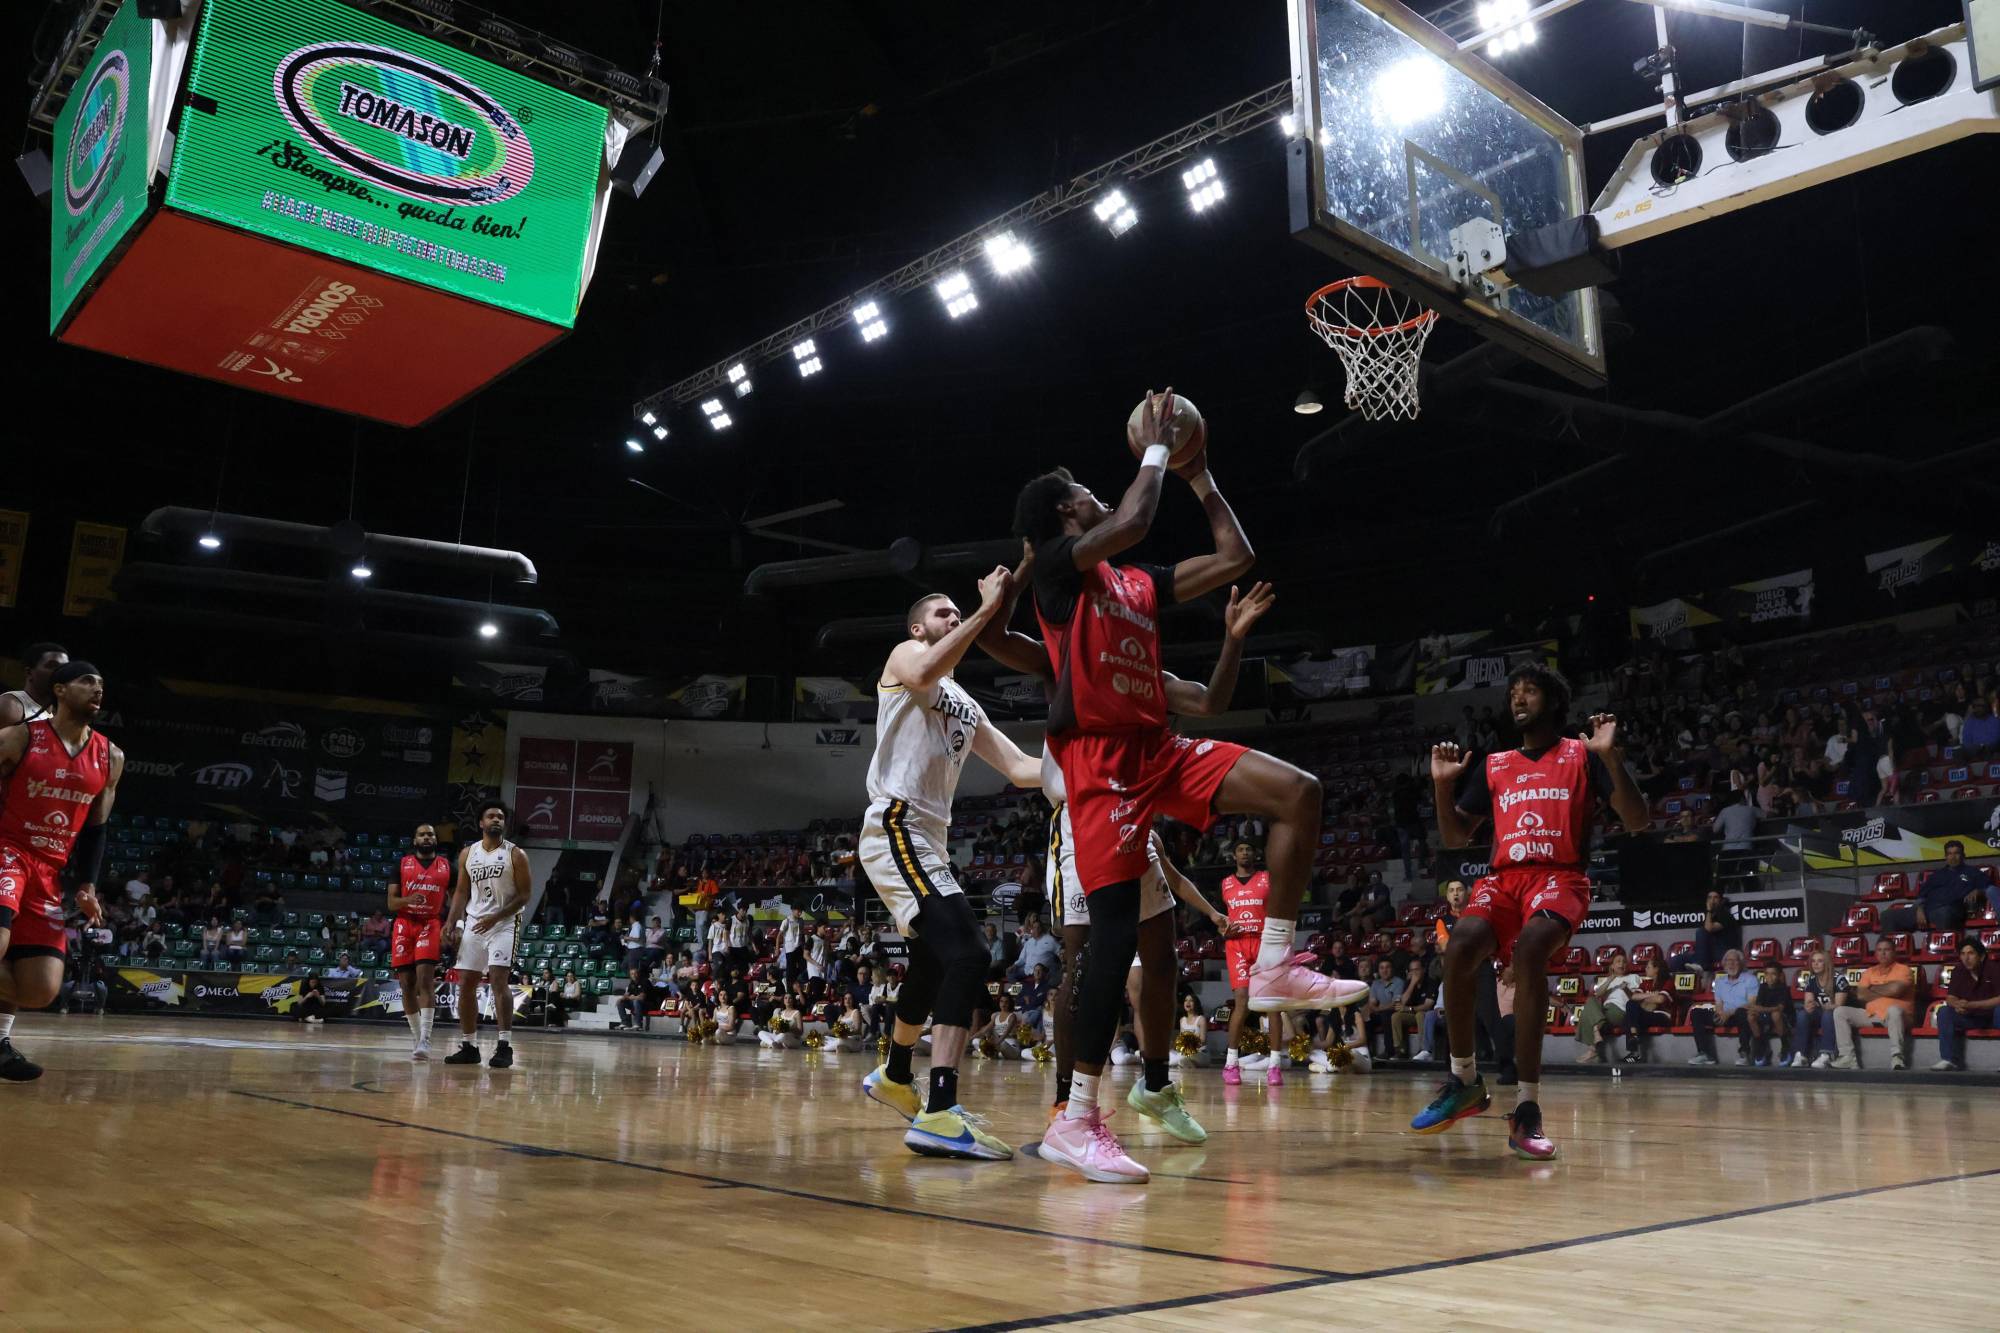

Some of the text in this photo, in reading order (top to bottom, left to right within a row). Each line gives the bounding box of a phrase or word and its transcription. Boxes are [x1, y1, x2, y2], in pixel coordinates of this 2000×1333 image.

[342, 84, 473, 157] TOMASON
[397, 202, 467, 232] queda
[472, 215, 527, 241] bien!
[283, 281, 356, 334] SONORA
[125, 758, 184, 778] omex
[523, 760, 568, 772] SONORA
[195, 768, 242, 786] LTH
[1499, 787, 1570, 814] VENADOS
[577, 813, 623, 825] SONORA
[1529, 828, 1562, 838] Azteca
[1842, 822, 1885, 843] RAYOS
[470, 864, 505, 883] RAYOS
[1653, 910, 1706, 928] Chevron
[1741, 904, 1798, 921] Chevron
[1563, 981, 1576, 991] 014
